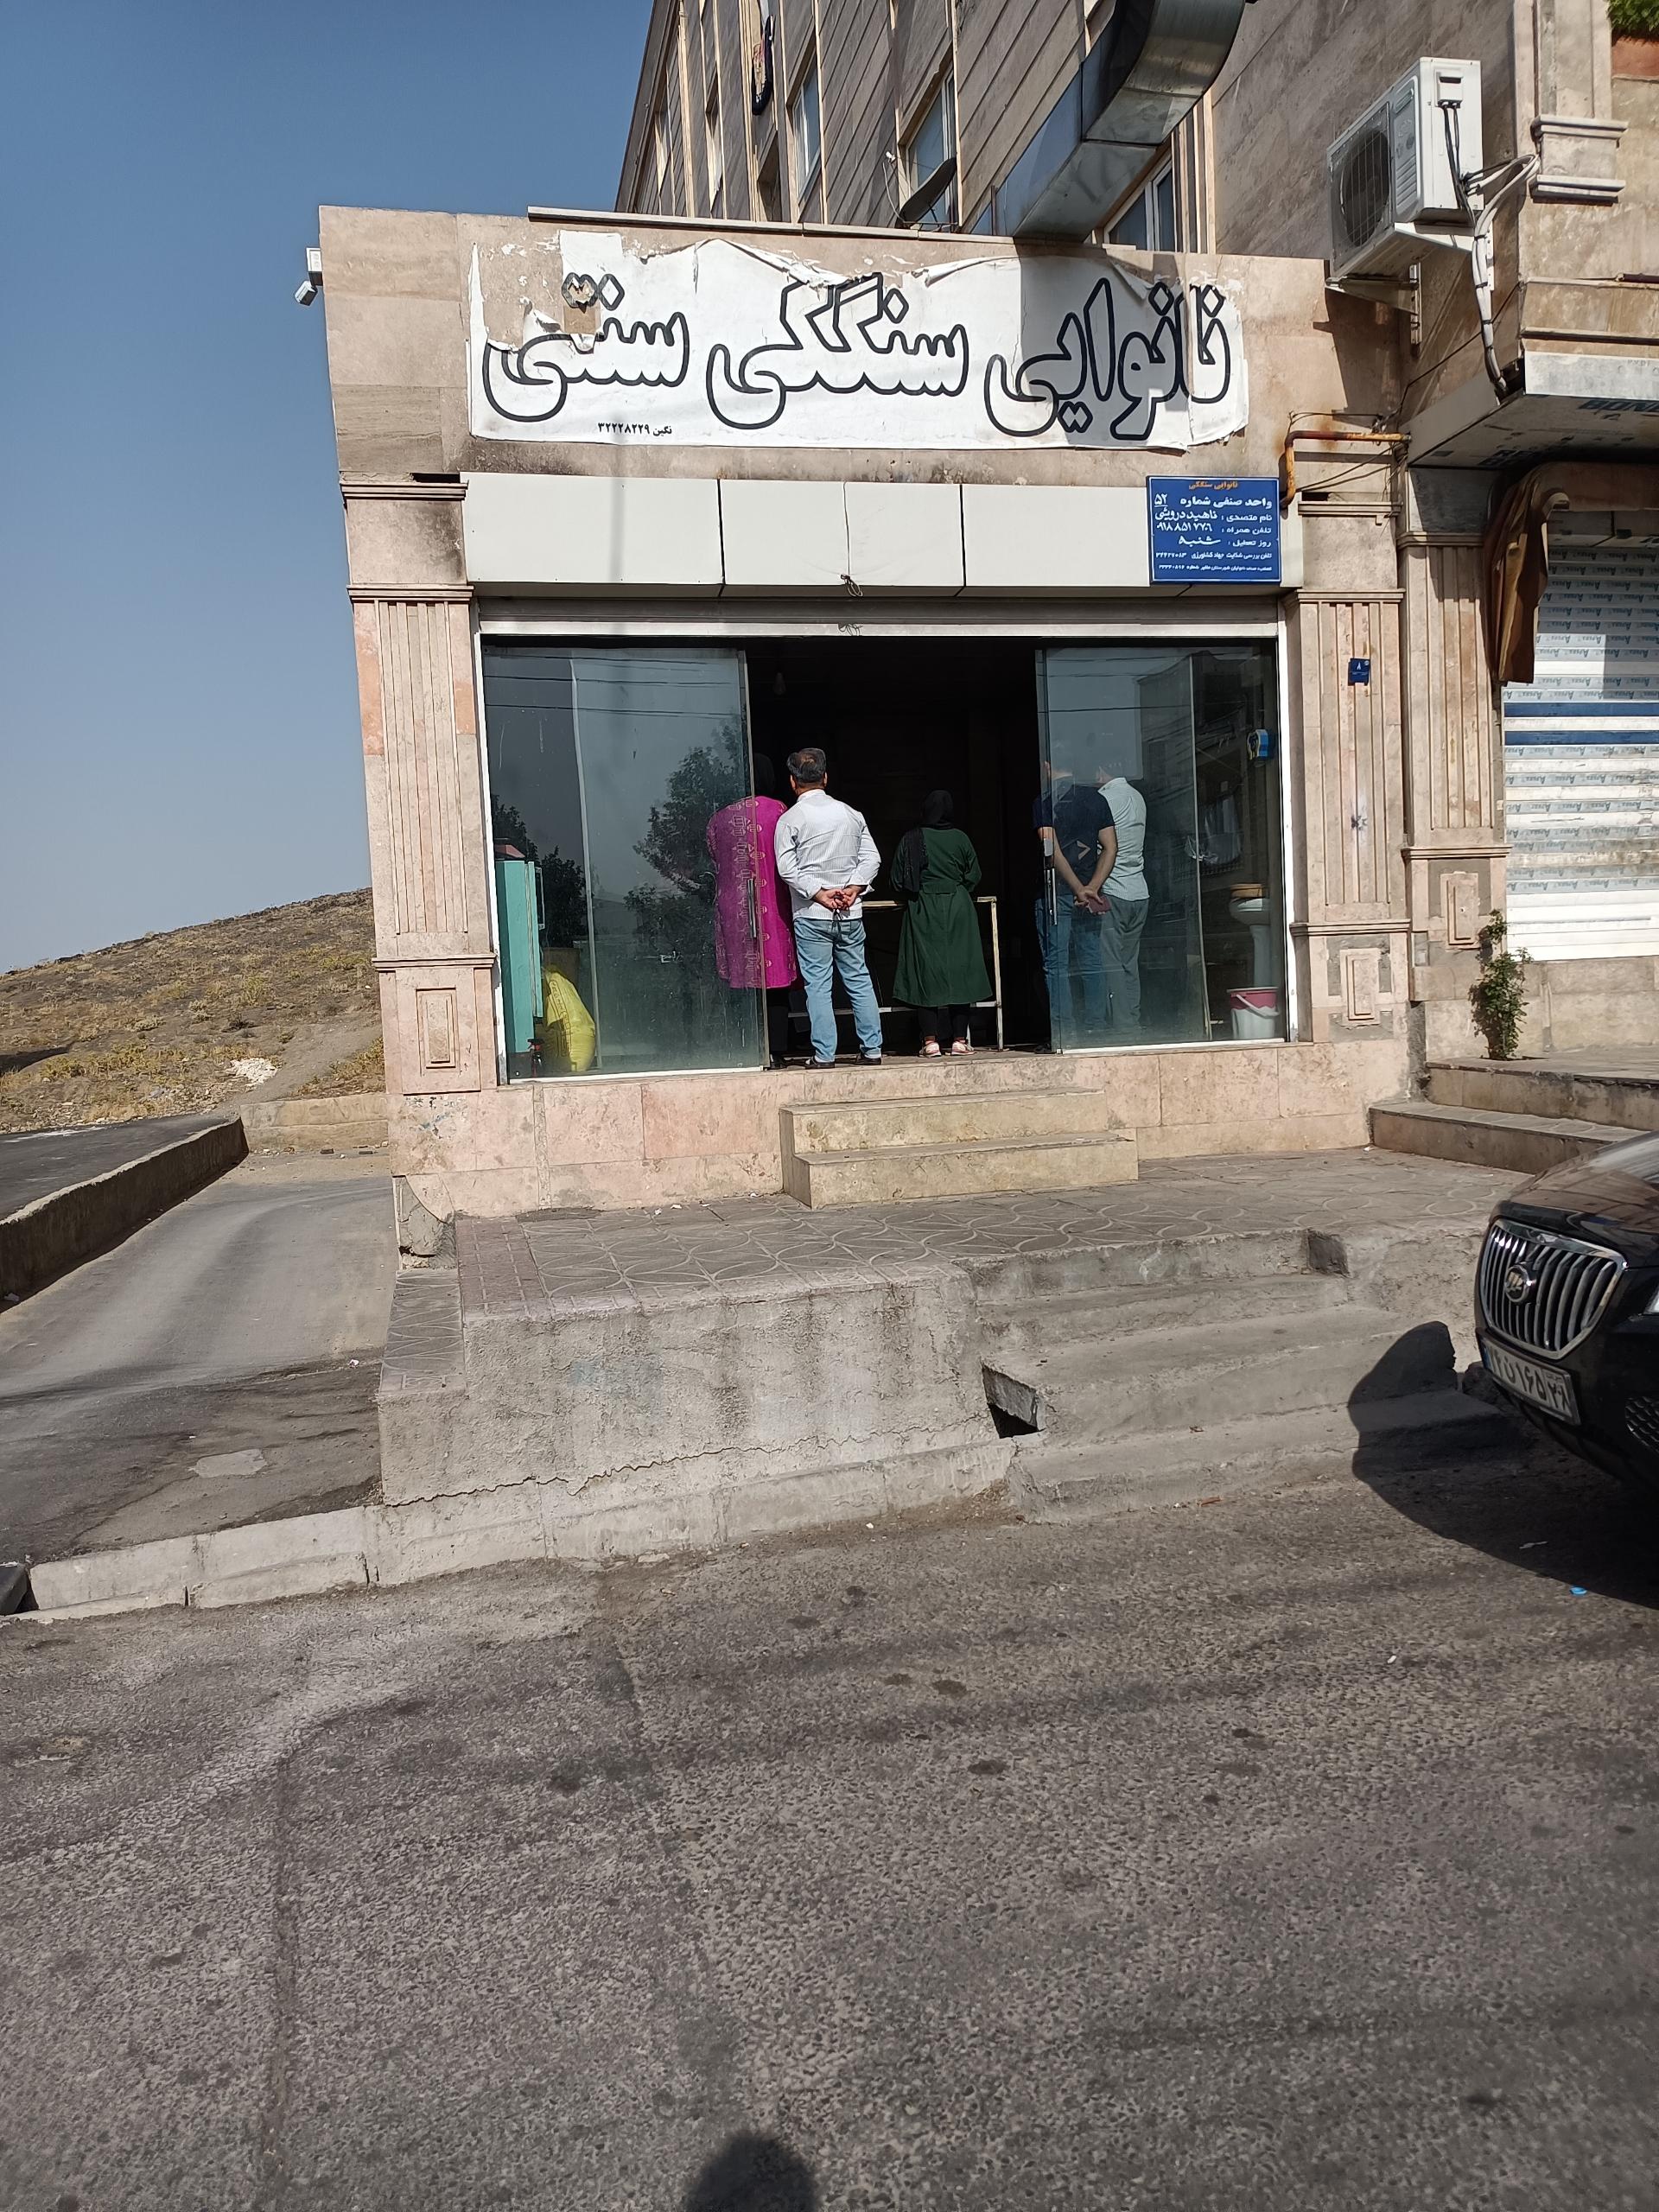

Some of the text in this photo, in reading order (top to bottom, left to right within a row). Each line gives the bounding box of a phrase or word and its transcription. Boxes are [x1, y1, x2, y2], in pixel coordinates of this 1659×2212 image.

[482, 272, 1230, 441] نانوایی سنگکی سنتی
[598, 423, 672, 436] نگین ۳۲۲۲۸۲۲۹
[1189, 480, 1238, 490] نانوایی سنگکی
[1154, 493, 1272, 509] واحد صنفی شماره ۵۲
[1154, 506, 1186, 521] درویشی
[1186, 509, 1217, 522] ناهید
[1259, 514, 1273, 524] نام
[1179, 535, 1221, 548] شنبه
[1192, 551, 1213, 560] کشاورزی
